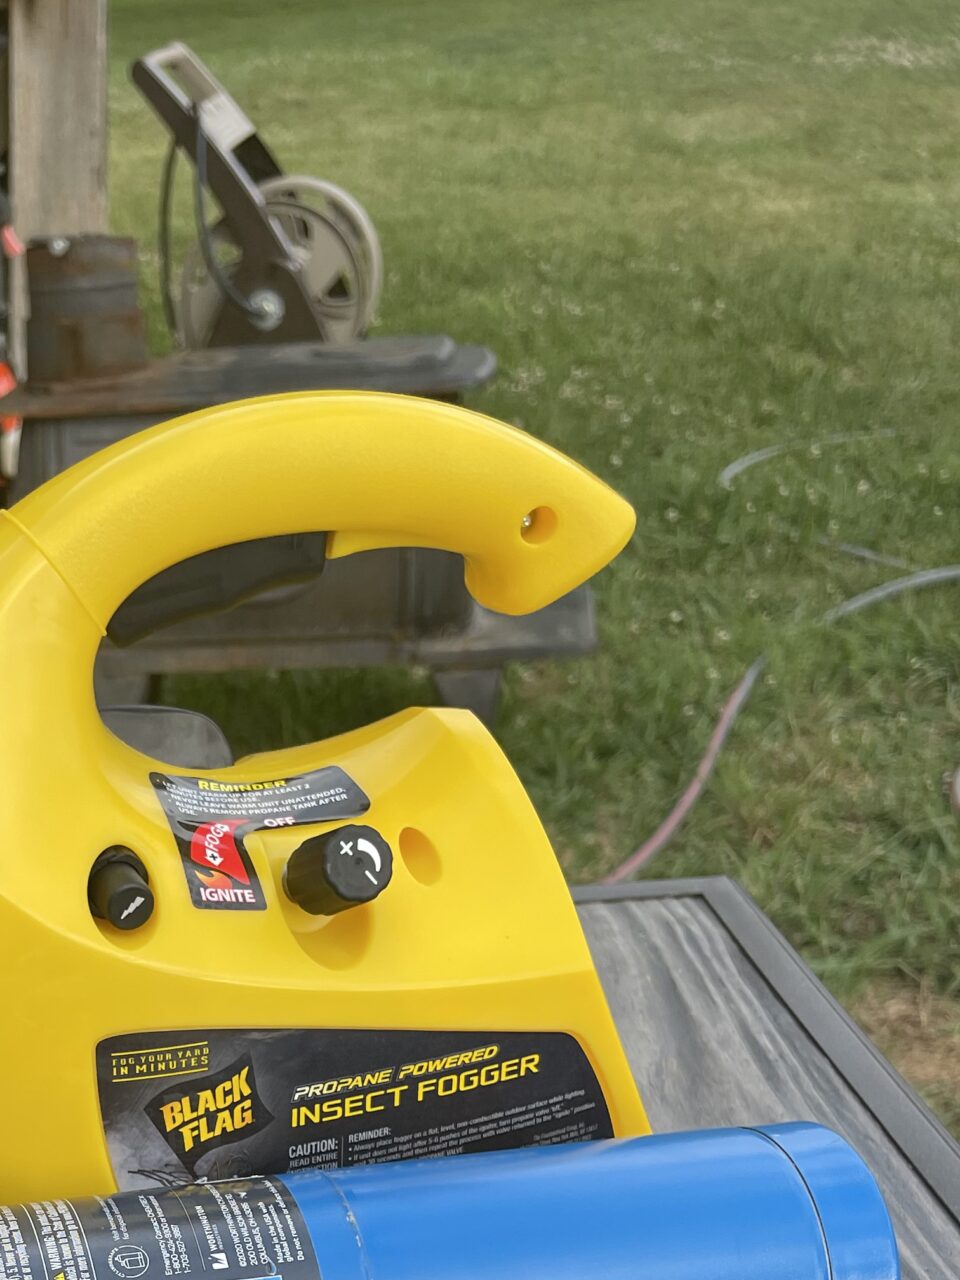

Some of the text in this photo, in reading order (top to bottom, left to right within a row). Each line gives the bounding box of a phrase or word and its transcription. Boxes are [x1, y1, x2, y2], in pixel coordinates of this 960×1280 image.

[198, 780, 287, 792] REMINDER
[243, 790, 262, 798] FOR
[276, 784, 301, 796] LEAST
[200, 800, 226, 808] LEAVE
[259, 800, 280, 809] UNIT
[204, 796, 239, 804] BEFORE
[210, 808, 248, 816] REMOVE
[249, 806, 292, 815] PROPANE
[293, 800, 318, 810] TANK
[320, 794, 348, 806] AFTER
[264, 817, 295, 827] OFF
[205, 826, 224, 852] FOG
[200, 888, 256, 902] IGNITE
[112, 1047, 210, 1066] FOG YOUR YARD
[112, 1056, 209, 1076] IN MINUTES
[293, 1045, 499, 1101] PROPANE POWERED
[160, 1066, 252, 1132] BLACK
[291, 1054, 540, 1128] INSECT FOGGER
[179, 1099, 253, 1152] FLAG
[348, 1127, 391, 1144] REMINDER:
[376, 1140, 392, 1148] place
[288, 1138, 338, 1159] CAUTION:
[290, 1158, 310, 1168] READ
[312, 1152, 338, 1163] ENTIRE
[258, 1202, 268, 1213] with
[277, 1193, 287, 1208] deface
[236, 1216, 251, 1237] WILSON
[248, 1219, 258, 1228] OH
[262, 1214, 272, 1226] USA
[286, 1215, 298, 1237] remove
[195, 1206, 218, 1252] WORTHINGTON
[220, 1204, 248, 1267] ©2020 WORTHINGTON
[267, 1226, 277, 1237] the
[268, 1204, 294, 1262] global components.
[68, 1230, 85, 1256] information
[244, 1237, 253, 1250] OLD
[252, 1227, 269, 1264] COLUMBUS,
[293, 1238, 302, 1250] not
[44, 1235, 62, 1270] WARNING:
[60, 1244, 73, 1260] known
[158, 1240, 173, 1276] Emergency
[248, 1250, 258, 1266] 200
[273, 1245, 284, 1263] Made
[296, 1251, 305, 1260] Do
[77, 1257, 89, 1270] more
